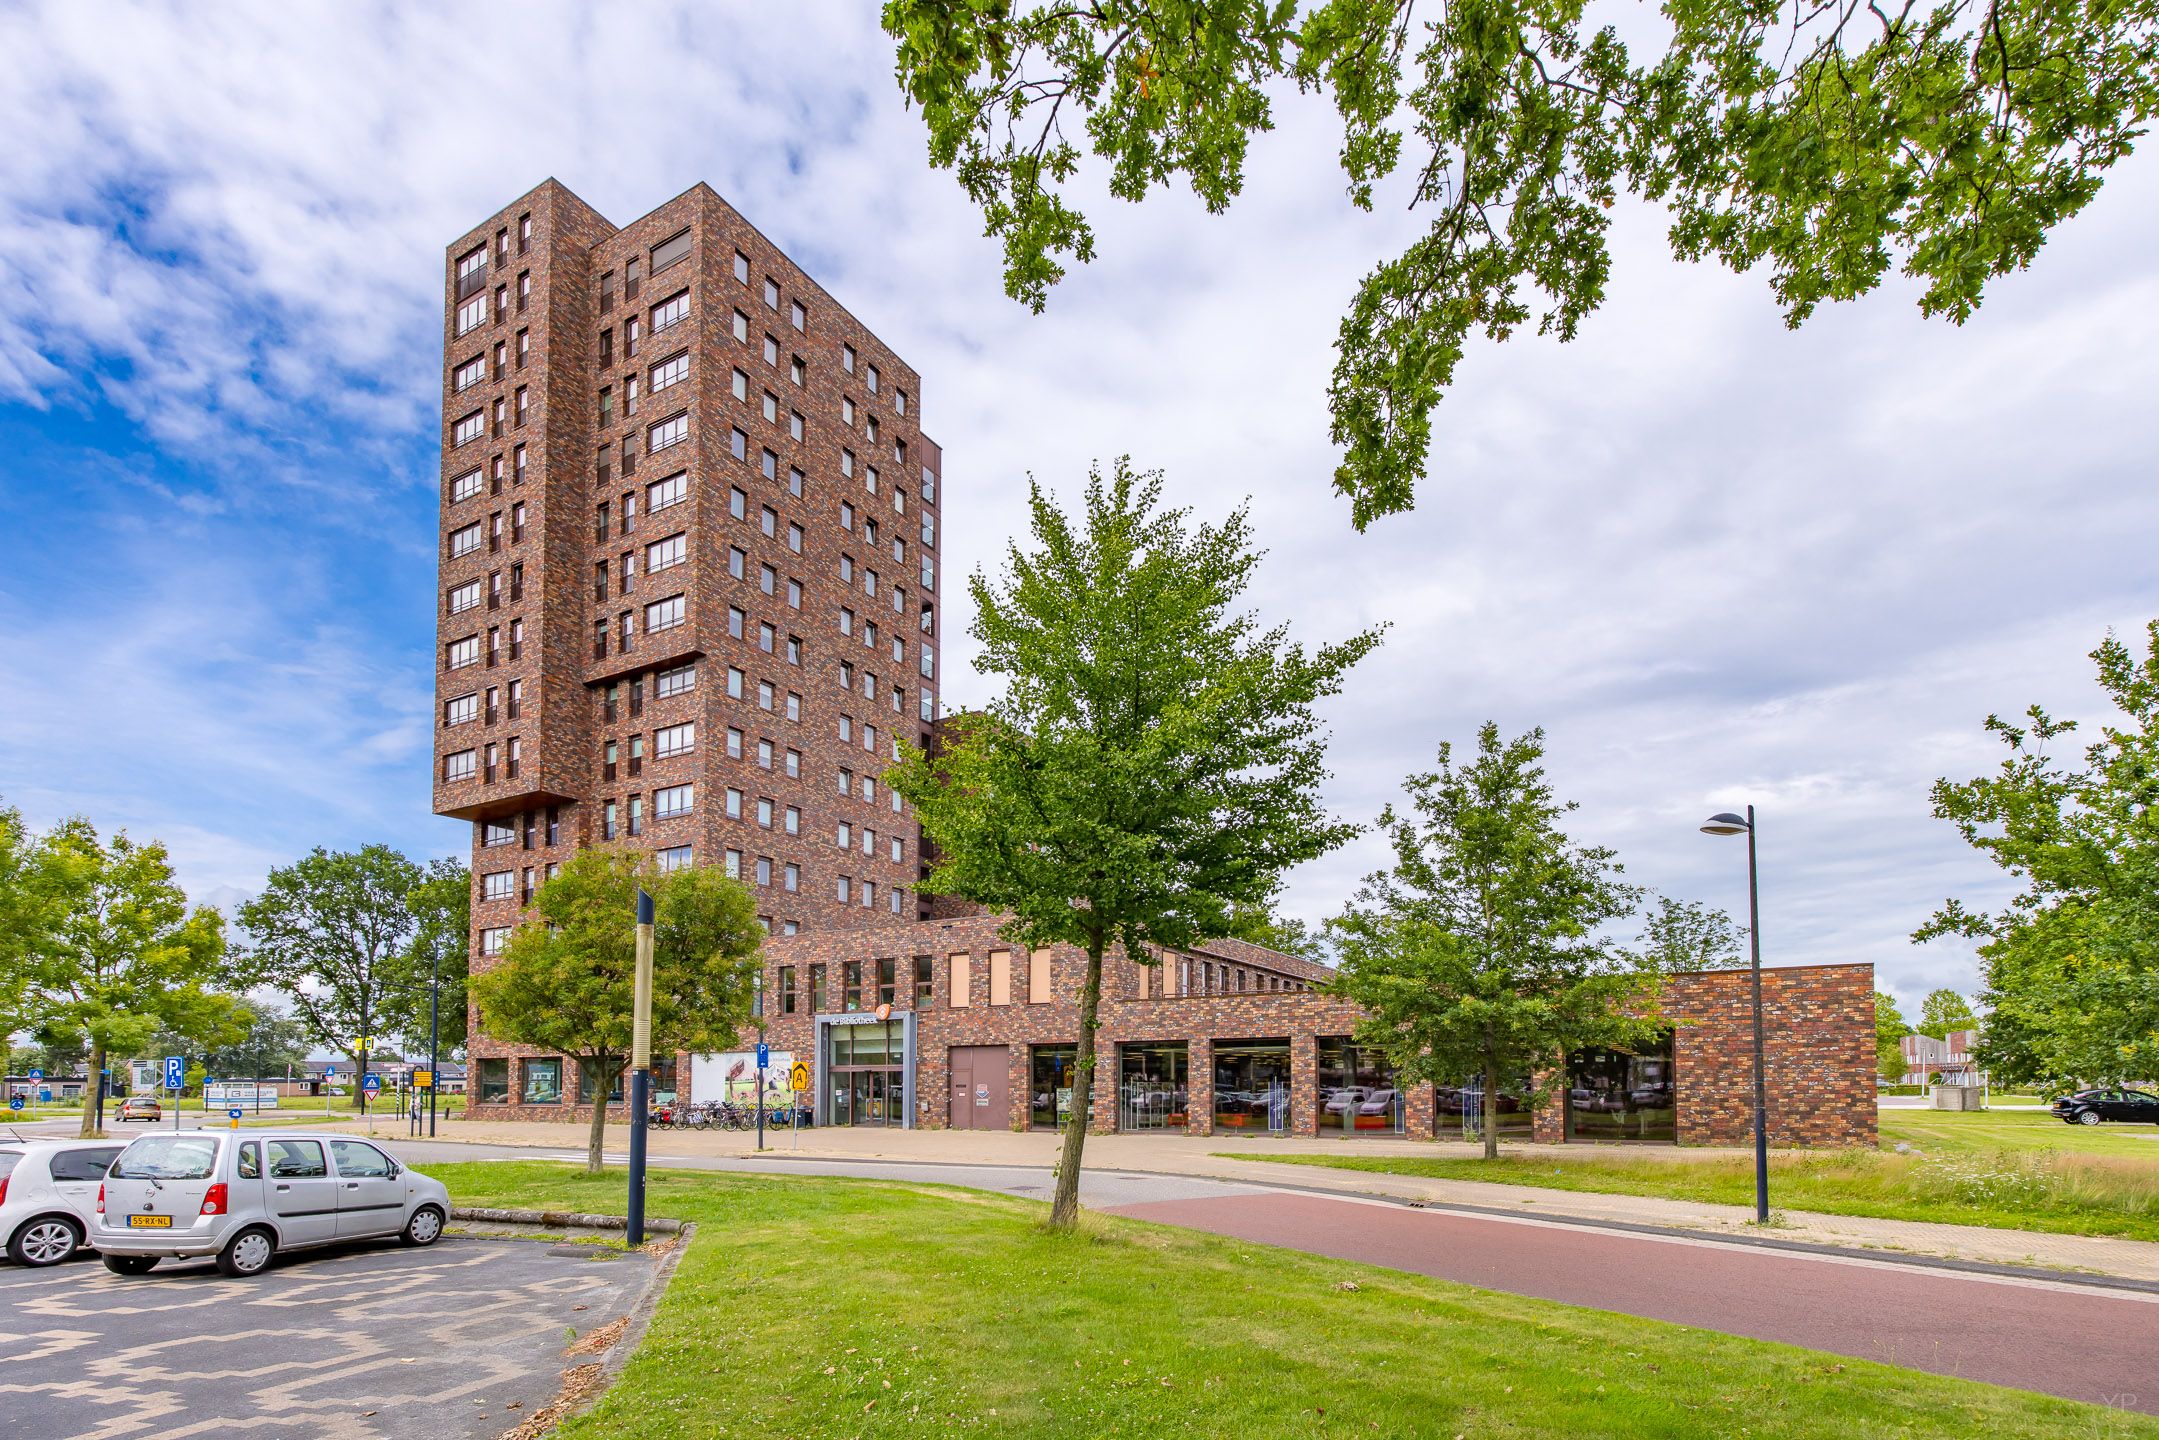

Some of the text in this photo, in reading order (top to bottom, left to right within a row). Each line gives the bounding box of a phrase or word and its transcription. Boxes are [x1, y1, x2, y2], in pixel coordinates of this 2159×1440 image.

[840, 1016, 878, 1025] Bibliotheek
[760, 1045, 767, 1054] P
[169, 1060, 179, 1075] P
[796, 1073, 803, 1083] A
[133, 1217, 169, 1225] 55-RX-NL
